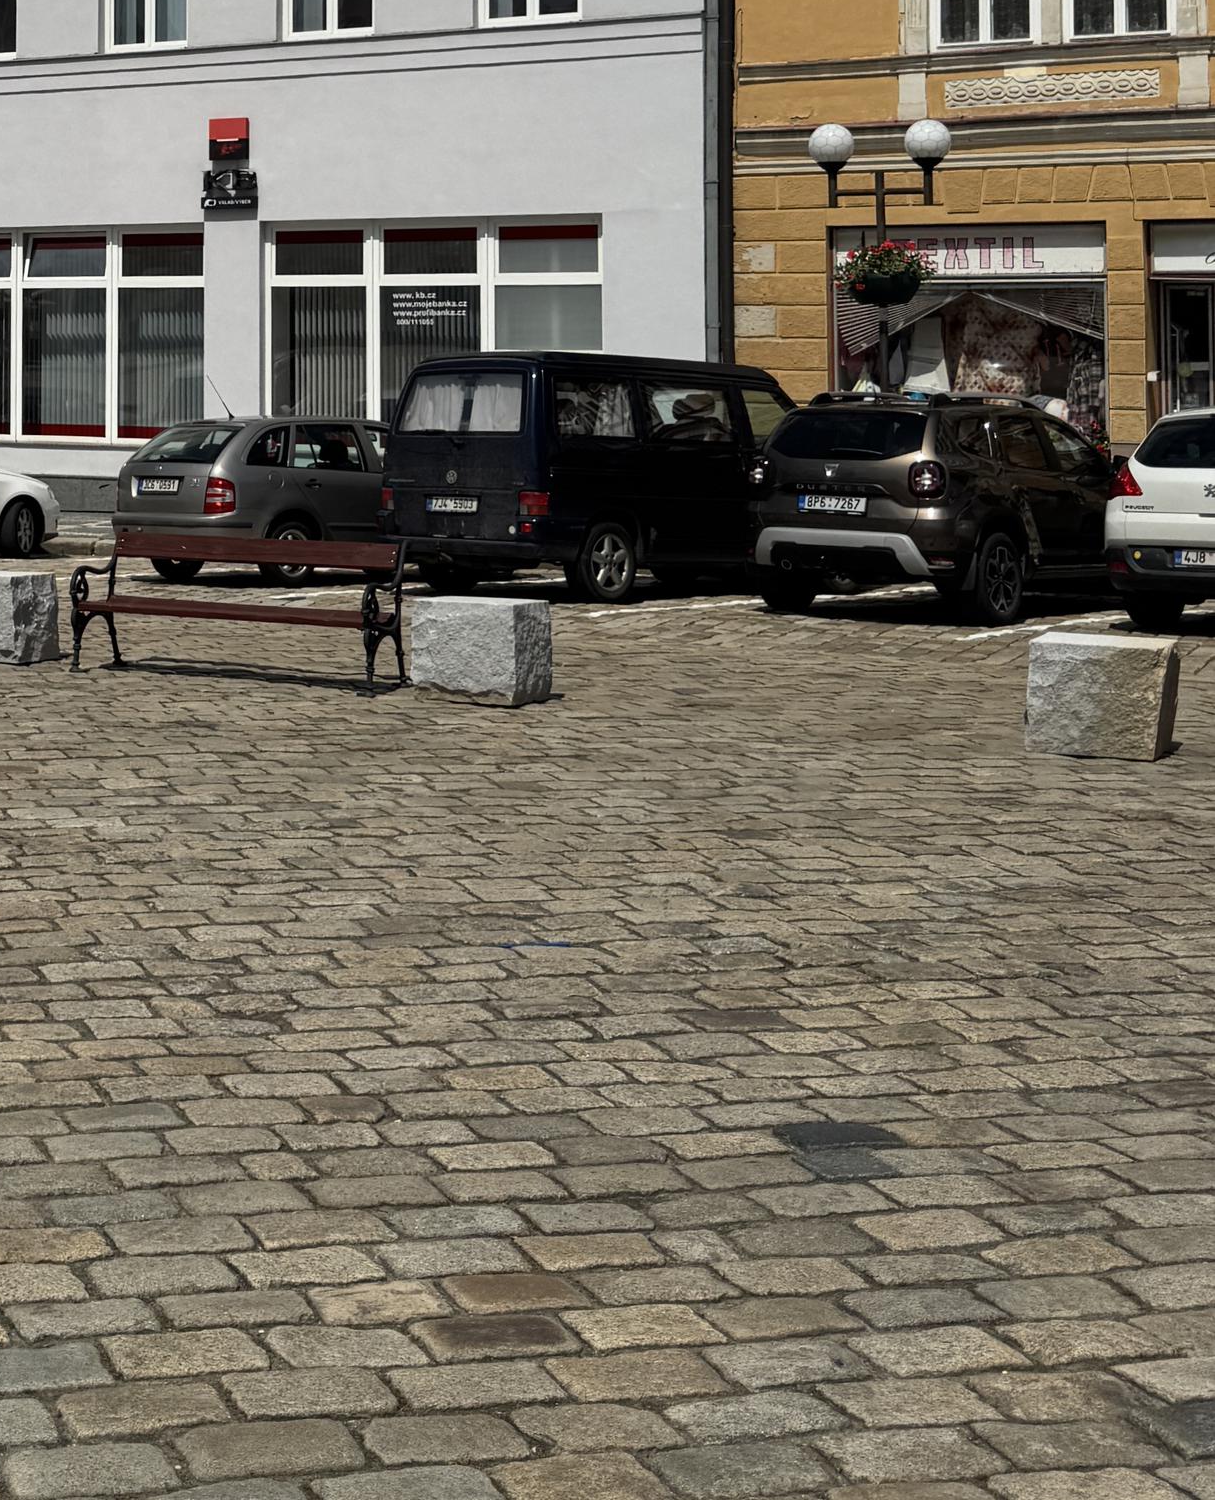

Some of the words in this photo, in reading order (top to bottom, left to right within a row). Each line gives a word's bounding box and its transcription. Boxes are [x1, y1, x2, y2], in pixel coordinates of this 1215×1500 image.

[807, 496, 826, 508] 8P6
[834, 498, 861, 510] 7267
[1184, 551, 1206, 564] 4J8
